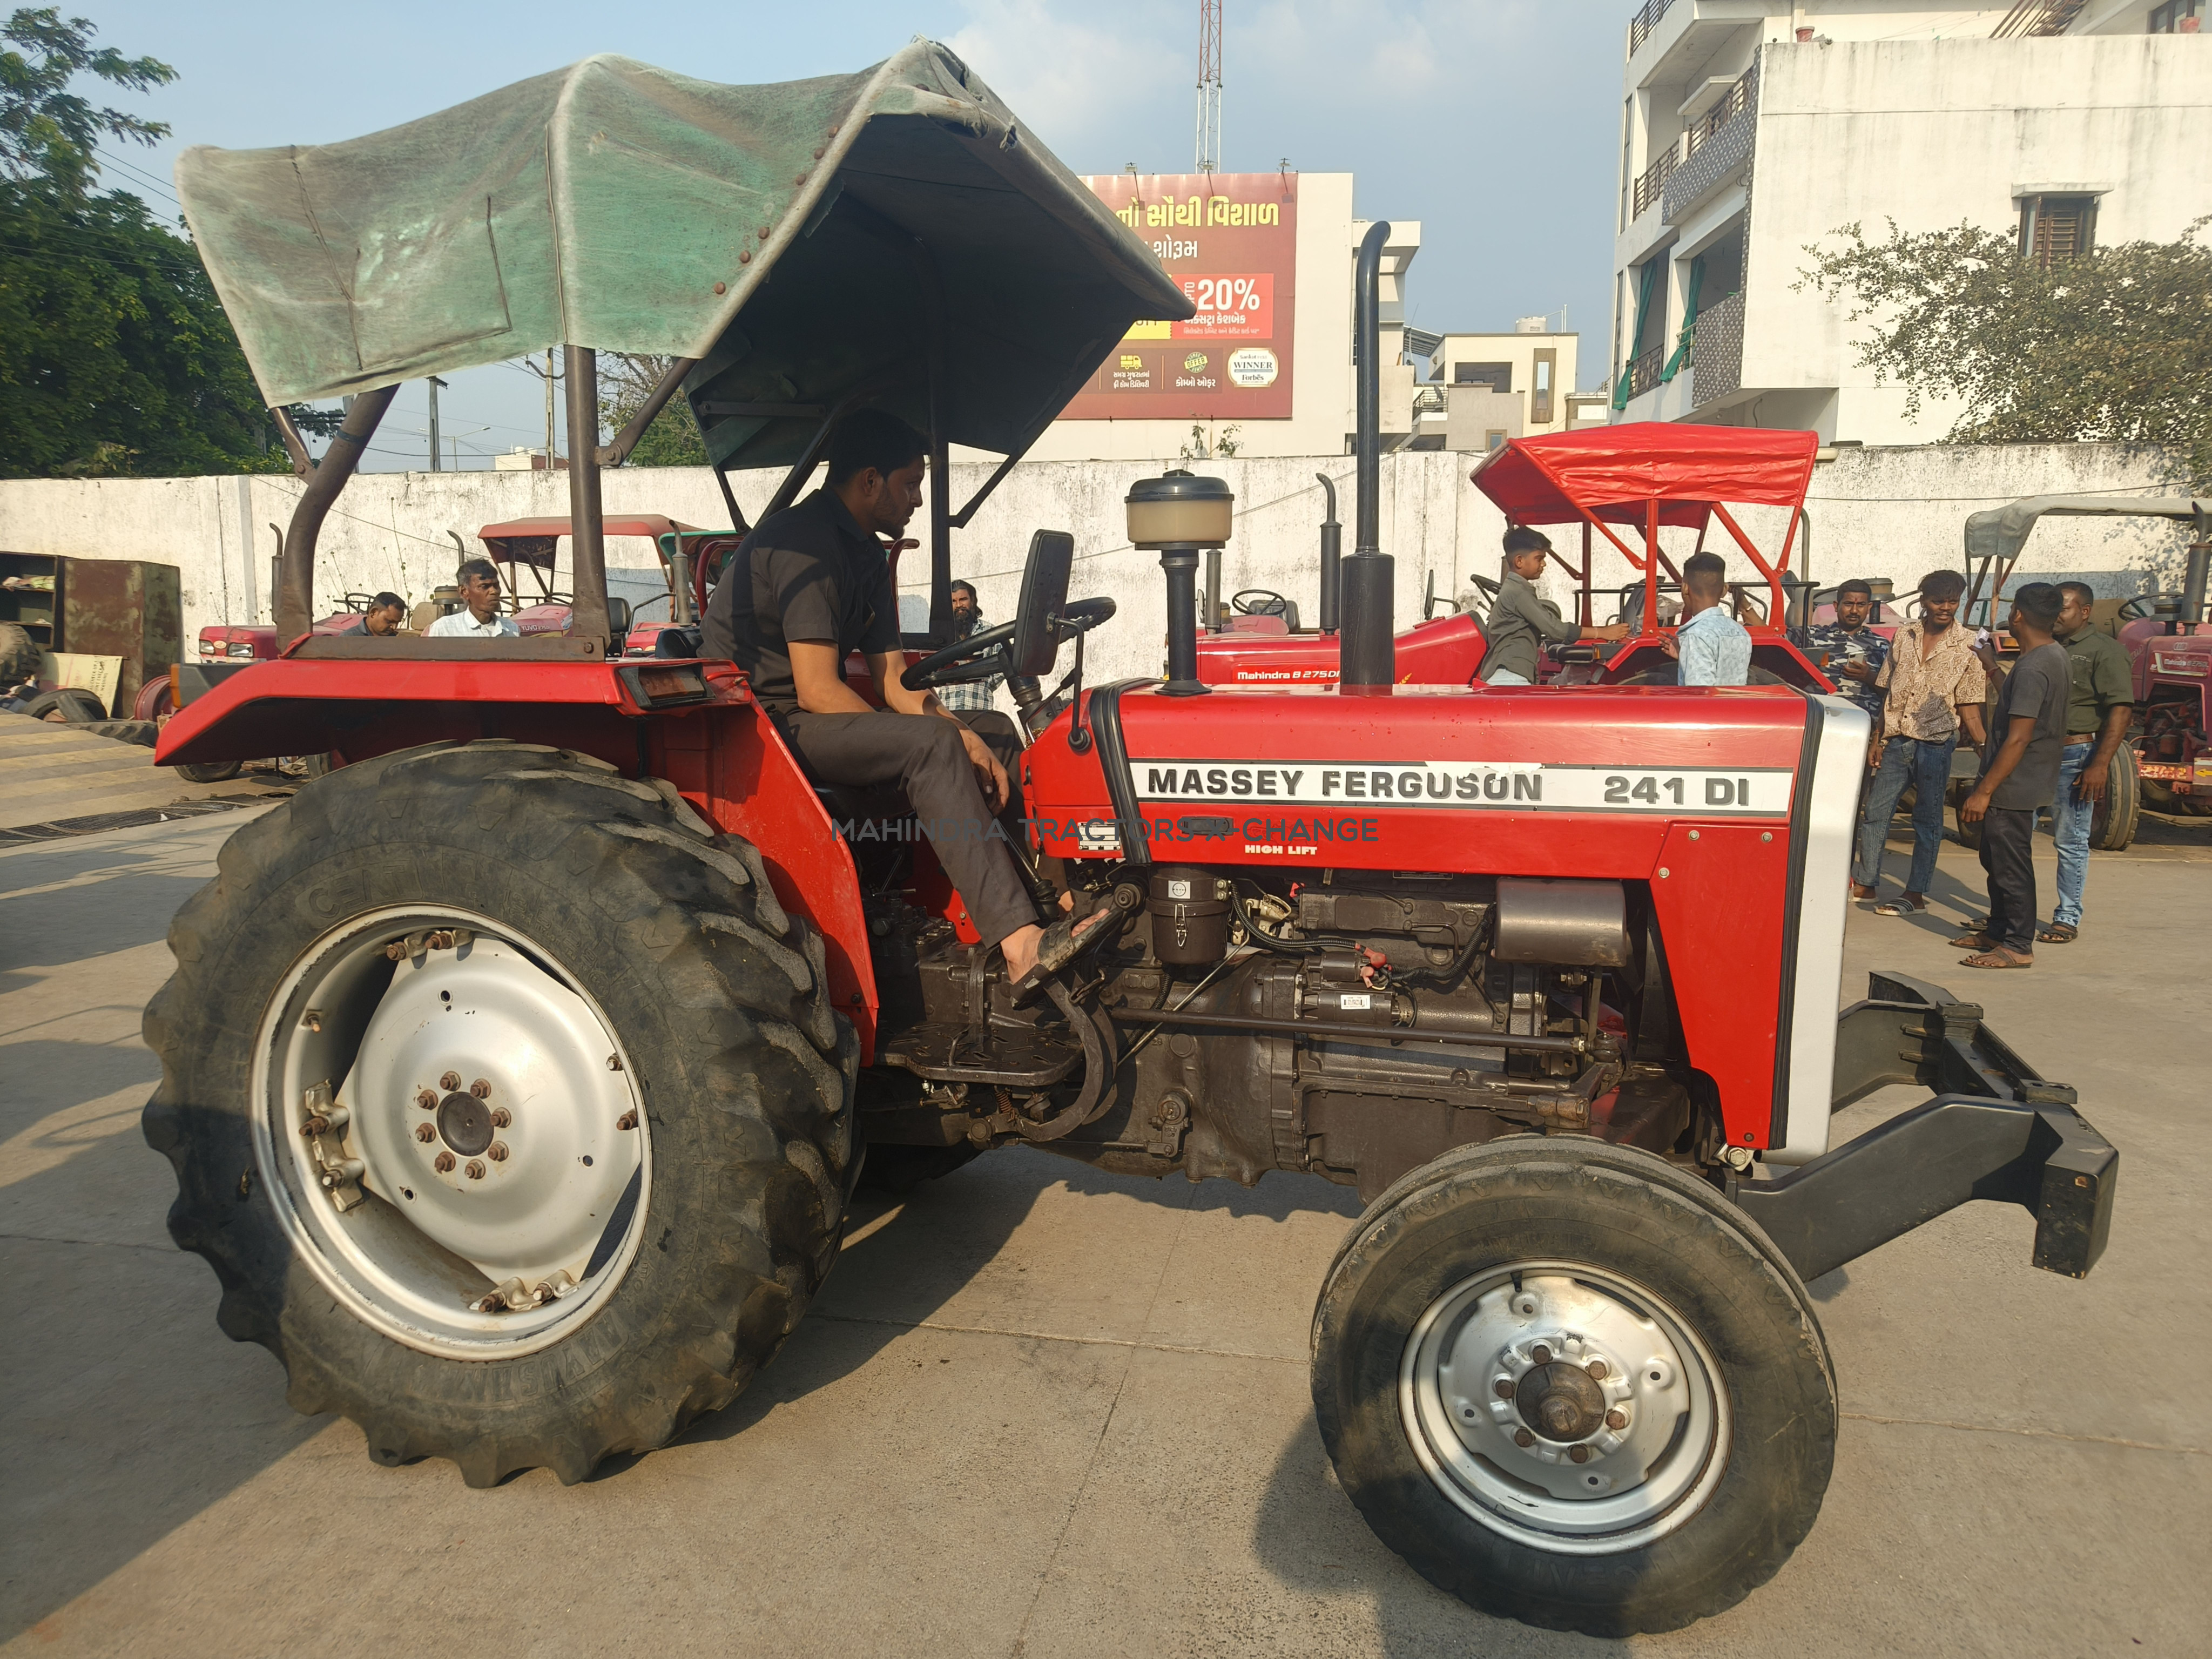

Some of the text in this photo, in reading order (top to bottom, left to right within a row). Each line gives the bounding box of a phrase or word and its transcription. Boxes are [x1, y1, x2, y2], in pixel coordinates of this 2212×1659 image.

[1147, 195, 1202, 227] સૌથી
[1207, 195, 1279, 226] વિશાળ
[1184, 281, 1195, 304] PTO
[1197, 278, 1260, 311] 20%
[1187, 357, 1205, 369] OFFER
[1238, 671, 1290, 680] Mahindra
[1148, 768, 1543, 801] MASSEY FERGUSON
[1604, 775, 1749, 806] 241 DI
[1244, 845, 1318, 855] HIGH LIFT
